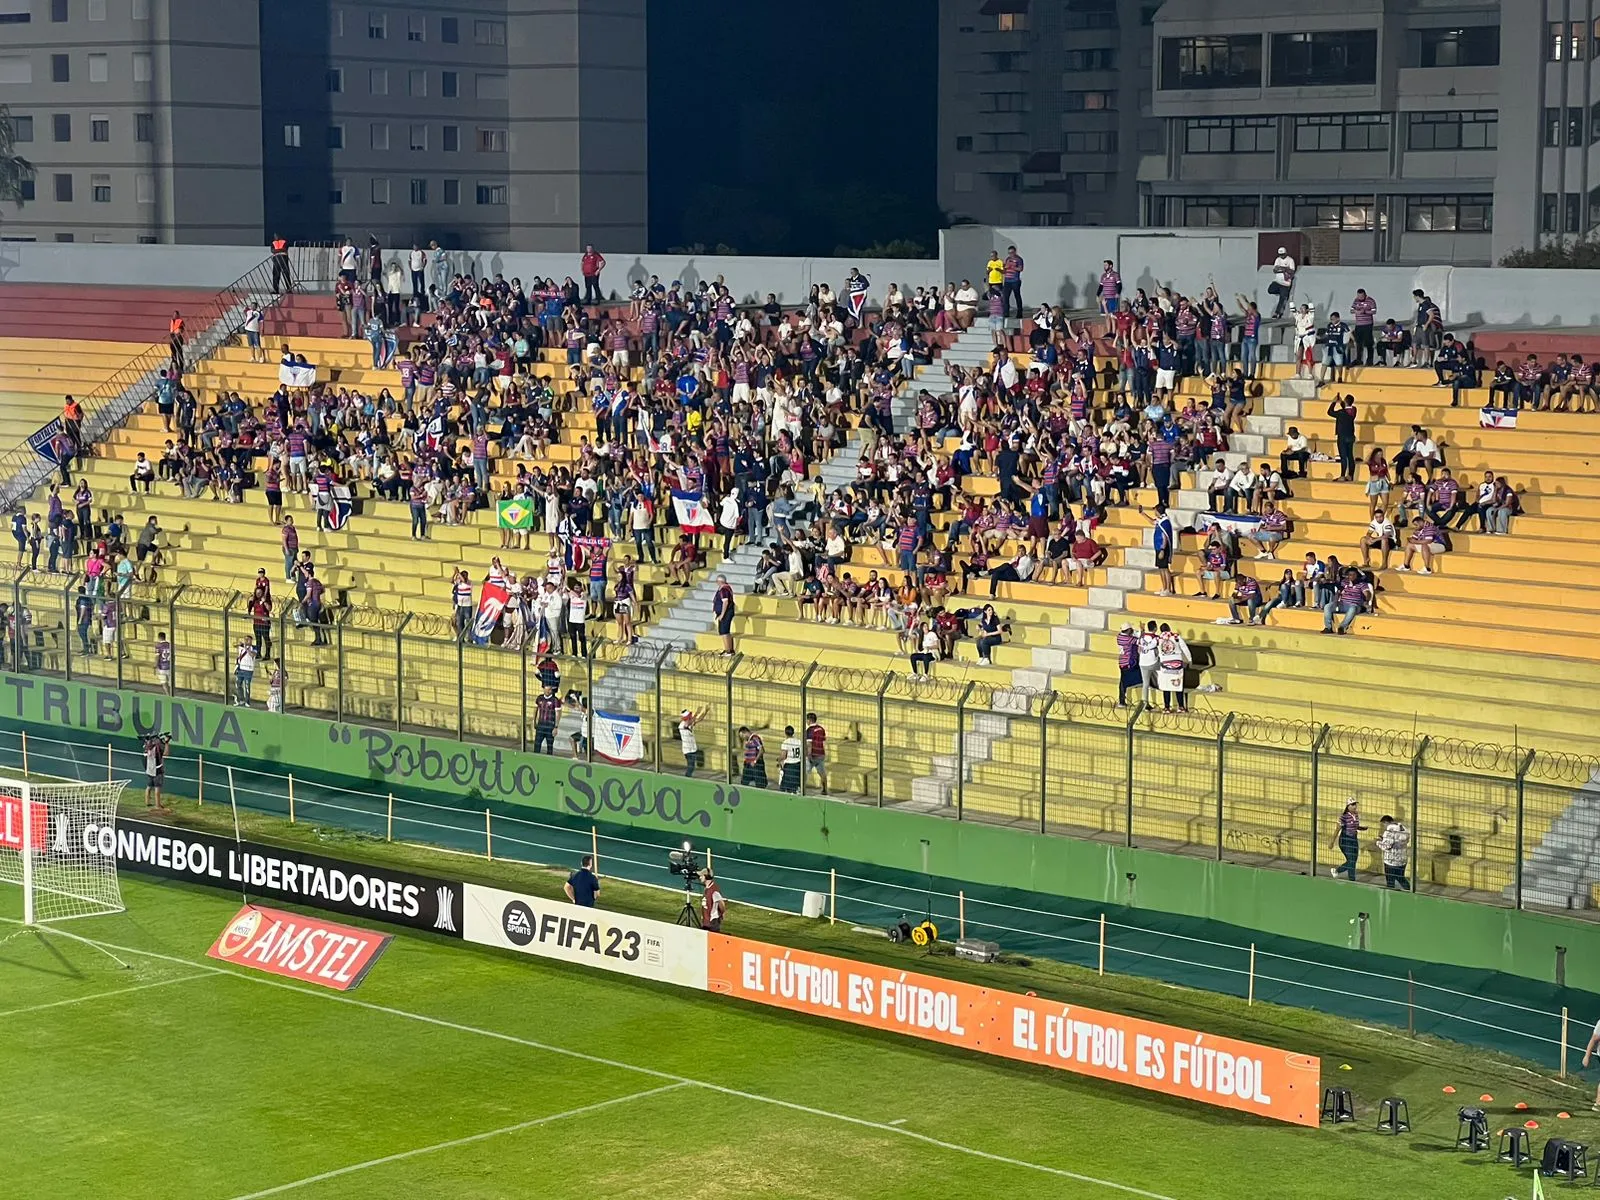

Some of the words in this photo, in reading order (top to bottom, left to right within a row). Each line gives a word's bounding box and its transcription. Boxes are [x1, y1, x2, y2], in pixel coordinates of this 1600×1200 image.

[5, 677, 247, 753] TRIBUNA
[83, 824, 222, 878] CONMEBOL
[229, 850, 420, 917] LIBERTADORES
[507, 924, 531, 936] SPORTS
[508, 908, 531, 927] EA
[539, 914, 601, 955] FIFA
[604, 927, 641, 961] 23
[647, 938, 660, 947] FIFA
[244, 919, 368, 983] AMSTEL
[742, 951, 765, 992] EL
[770, 950, 842, 1009] FÚTBOL
[848, 973, 874, 1016] ES
[880, 972, 965, 1036] FÚTBOL
[1013, 1006, 1038, 1051] EL
[1045, 1007, 1129, 1073] FÚTBOL
[1135, 1033, 1165, 1080] ES
[1173, 1034, 1271, 1105] FÚTBOL
